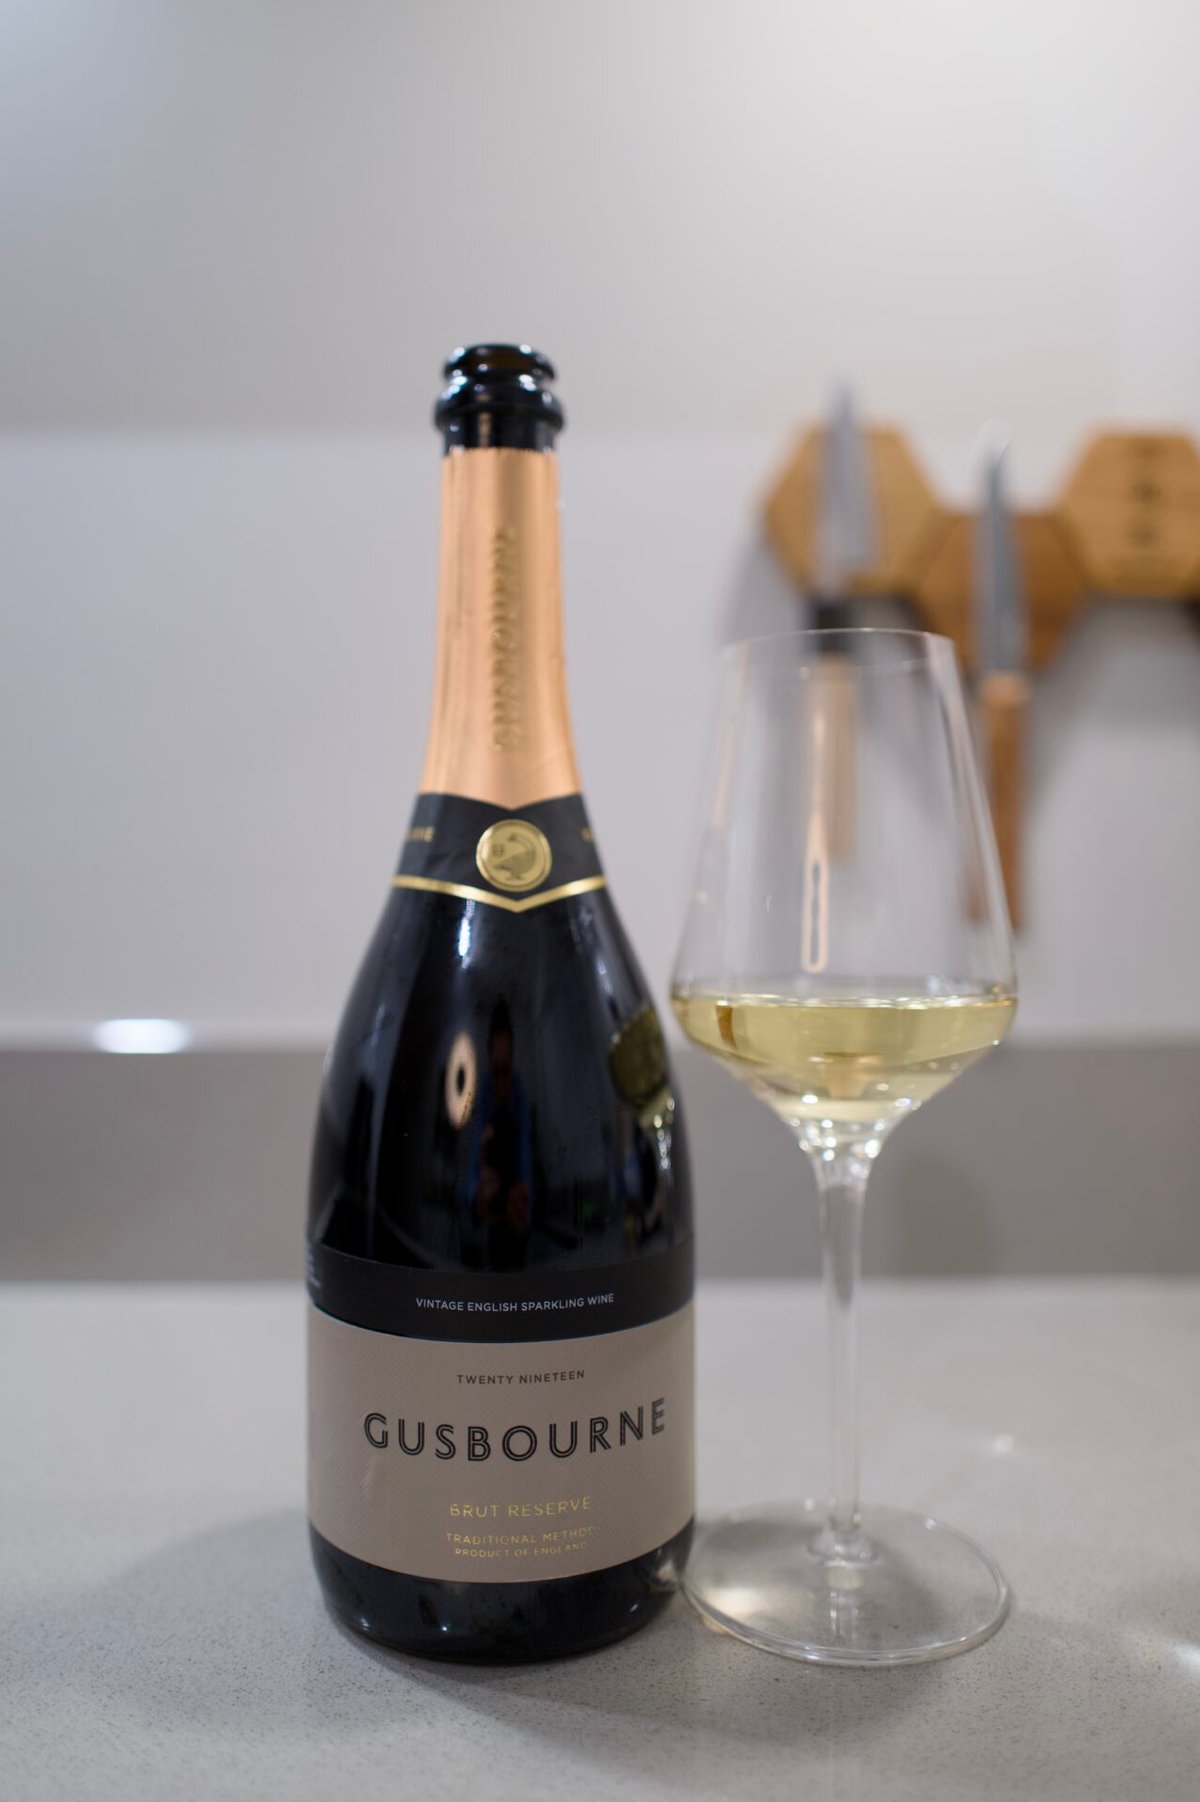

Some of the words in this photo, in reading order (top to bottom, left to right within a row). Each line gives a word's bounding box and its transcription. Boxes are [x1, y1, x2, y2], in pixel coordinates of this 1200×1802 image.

[415, 1297, 465, 1311] VINTAGE
[467, 1302, 518, 1312] ENGLISH
[521, 1297, 585, 1311] SPARKLING
[587, 1293, 615, 1306] WINE
[456, 1374, 514, 1385] TWENTY
[519, 1369, 585, 1384] NINETEEN
[363, 1397, 665, 1462] GUSBOURNE
[449, 1503, 499, 1518] BRUT
[508, 1496, 592, 1518] RESERVE
[446, 1532, 536, 1545] TRADITIONAL
[455, 1548, 510, 1558] PRODUCT
[514, 1549, 528, 1557] OF
